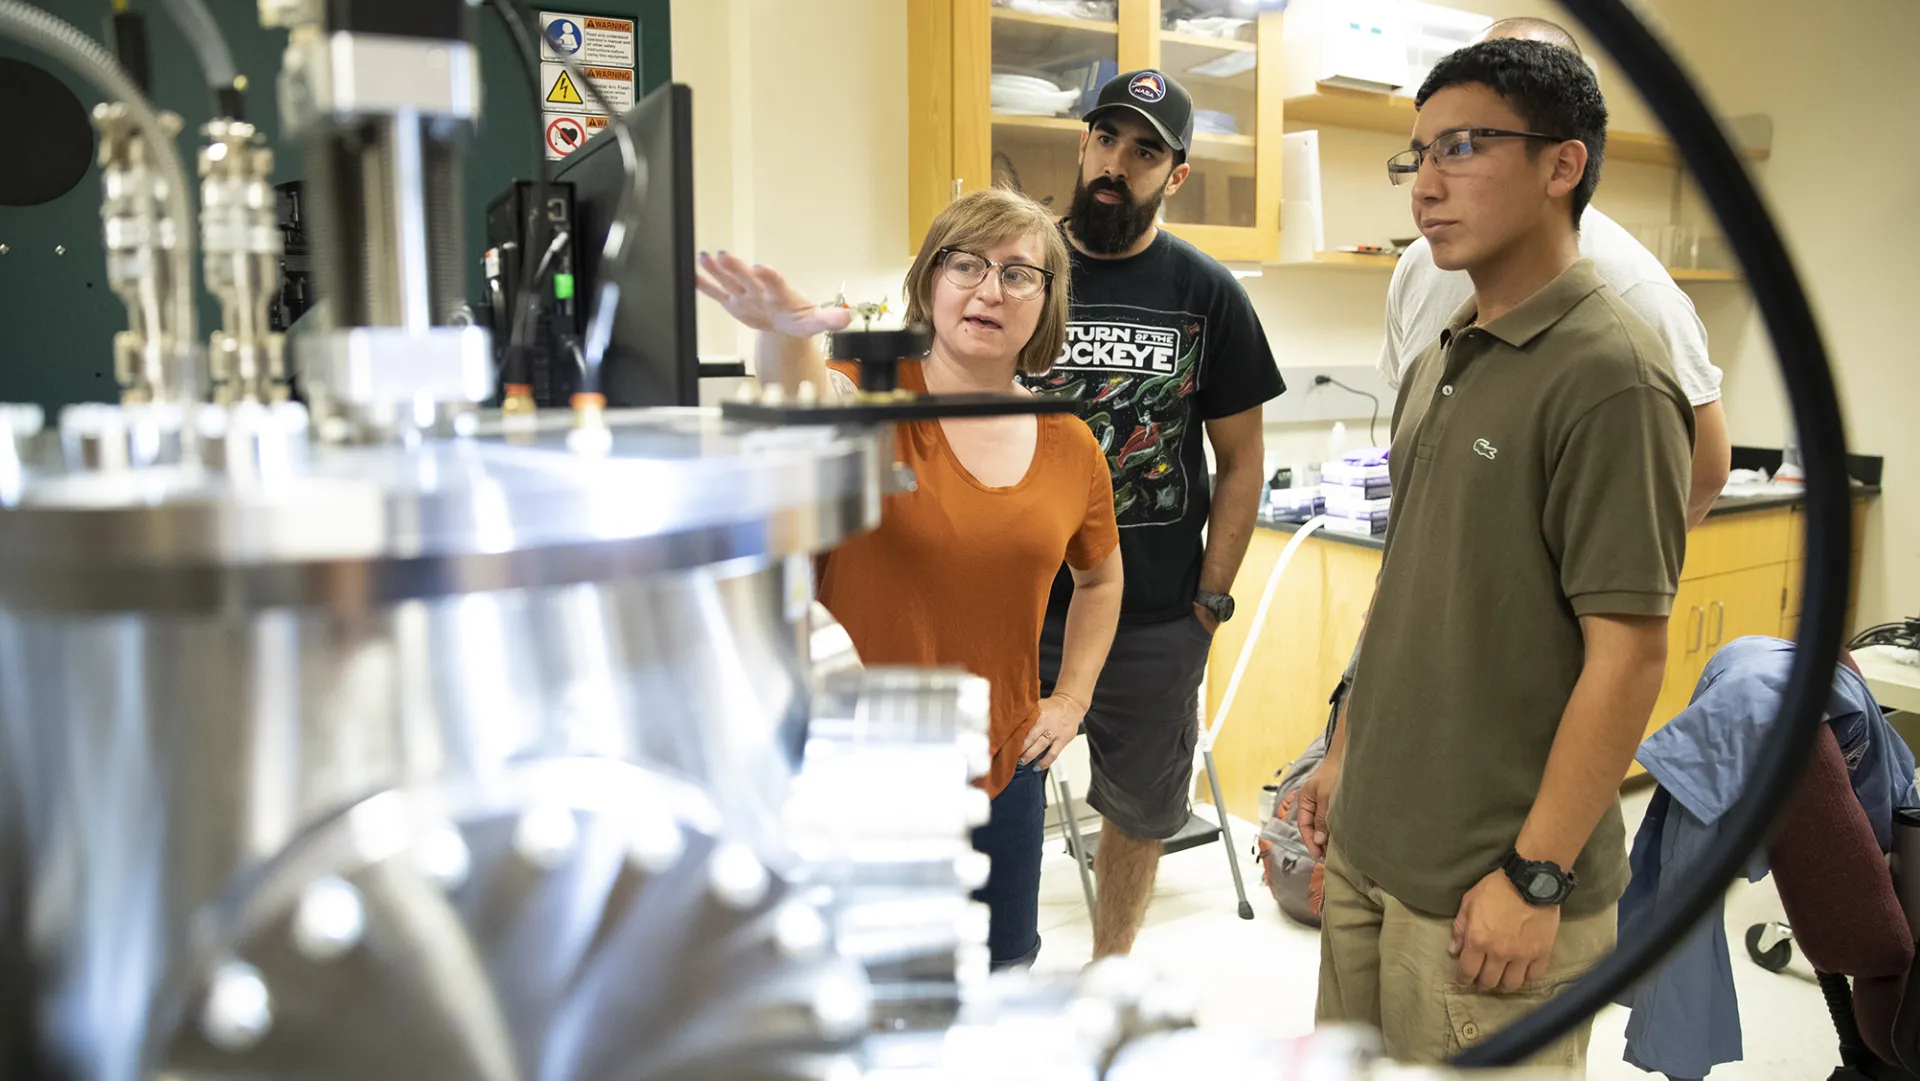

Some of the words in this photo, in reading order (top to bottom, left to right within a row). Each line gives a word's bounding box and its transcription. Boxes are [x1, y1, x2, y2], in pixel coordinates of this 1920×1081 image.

[595, 20, 630, 31] WARNING
[595, 69, 630, 80] WARNING
[1134, 88, 1154, 98] NASA
[1066, 326, 1131, 342] TURN
[1135, 333, 1149, 341] OF
[1151, 335, 1174, 344] THE
[1055, 341, 1174, 371] OCKEYE
